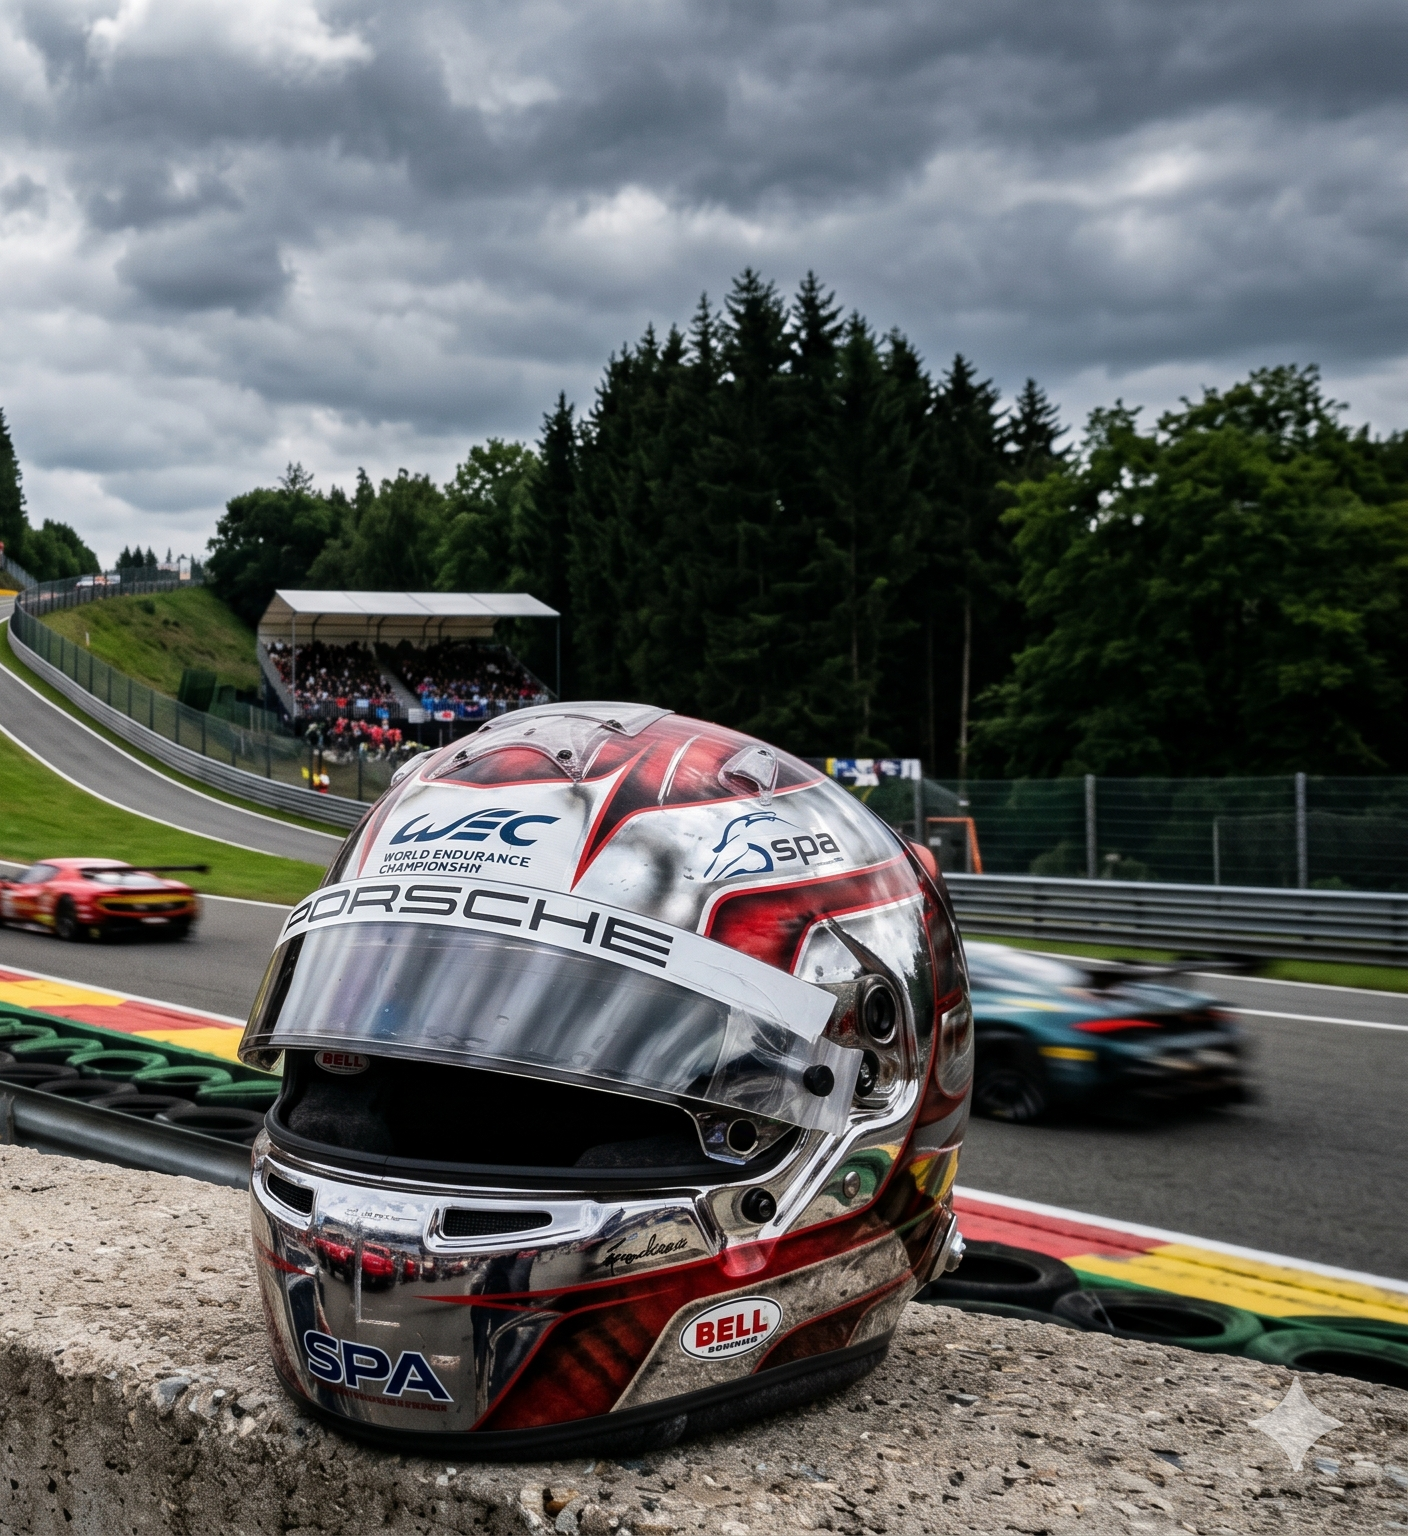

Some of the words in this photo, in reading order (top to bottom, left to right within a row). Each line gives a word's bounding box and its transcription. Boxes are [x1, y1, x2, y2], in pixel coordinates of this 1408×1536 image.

[389, 807, 562, 847] WEC
[383, 849, 431, 863] WORLD
[432, 849, 532, 868] ENDURANCE
[770, 832, 841, 866] spa
[283, 884, 674, 969] PORSCHE
[322, 1052, 364, 1068] BELL
[695, 1308, 768, 1349] BELL
[303, 1329, 455, 1403] SPA
